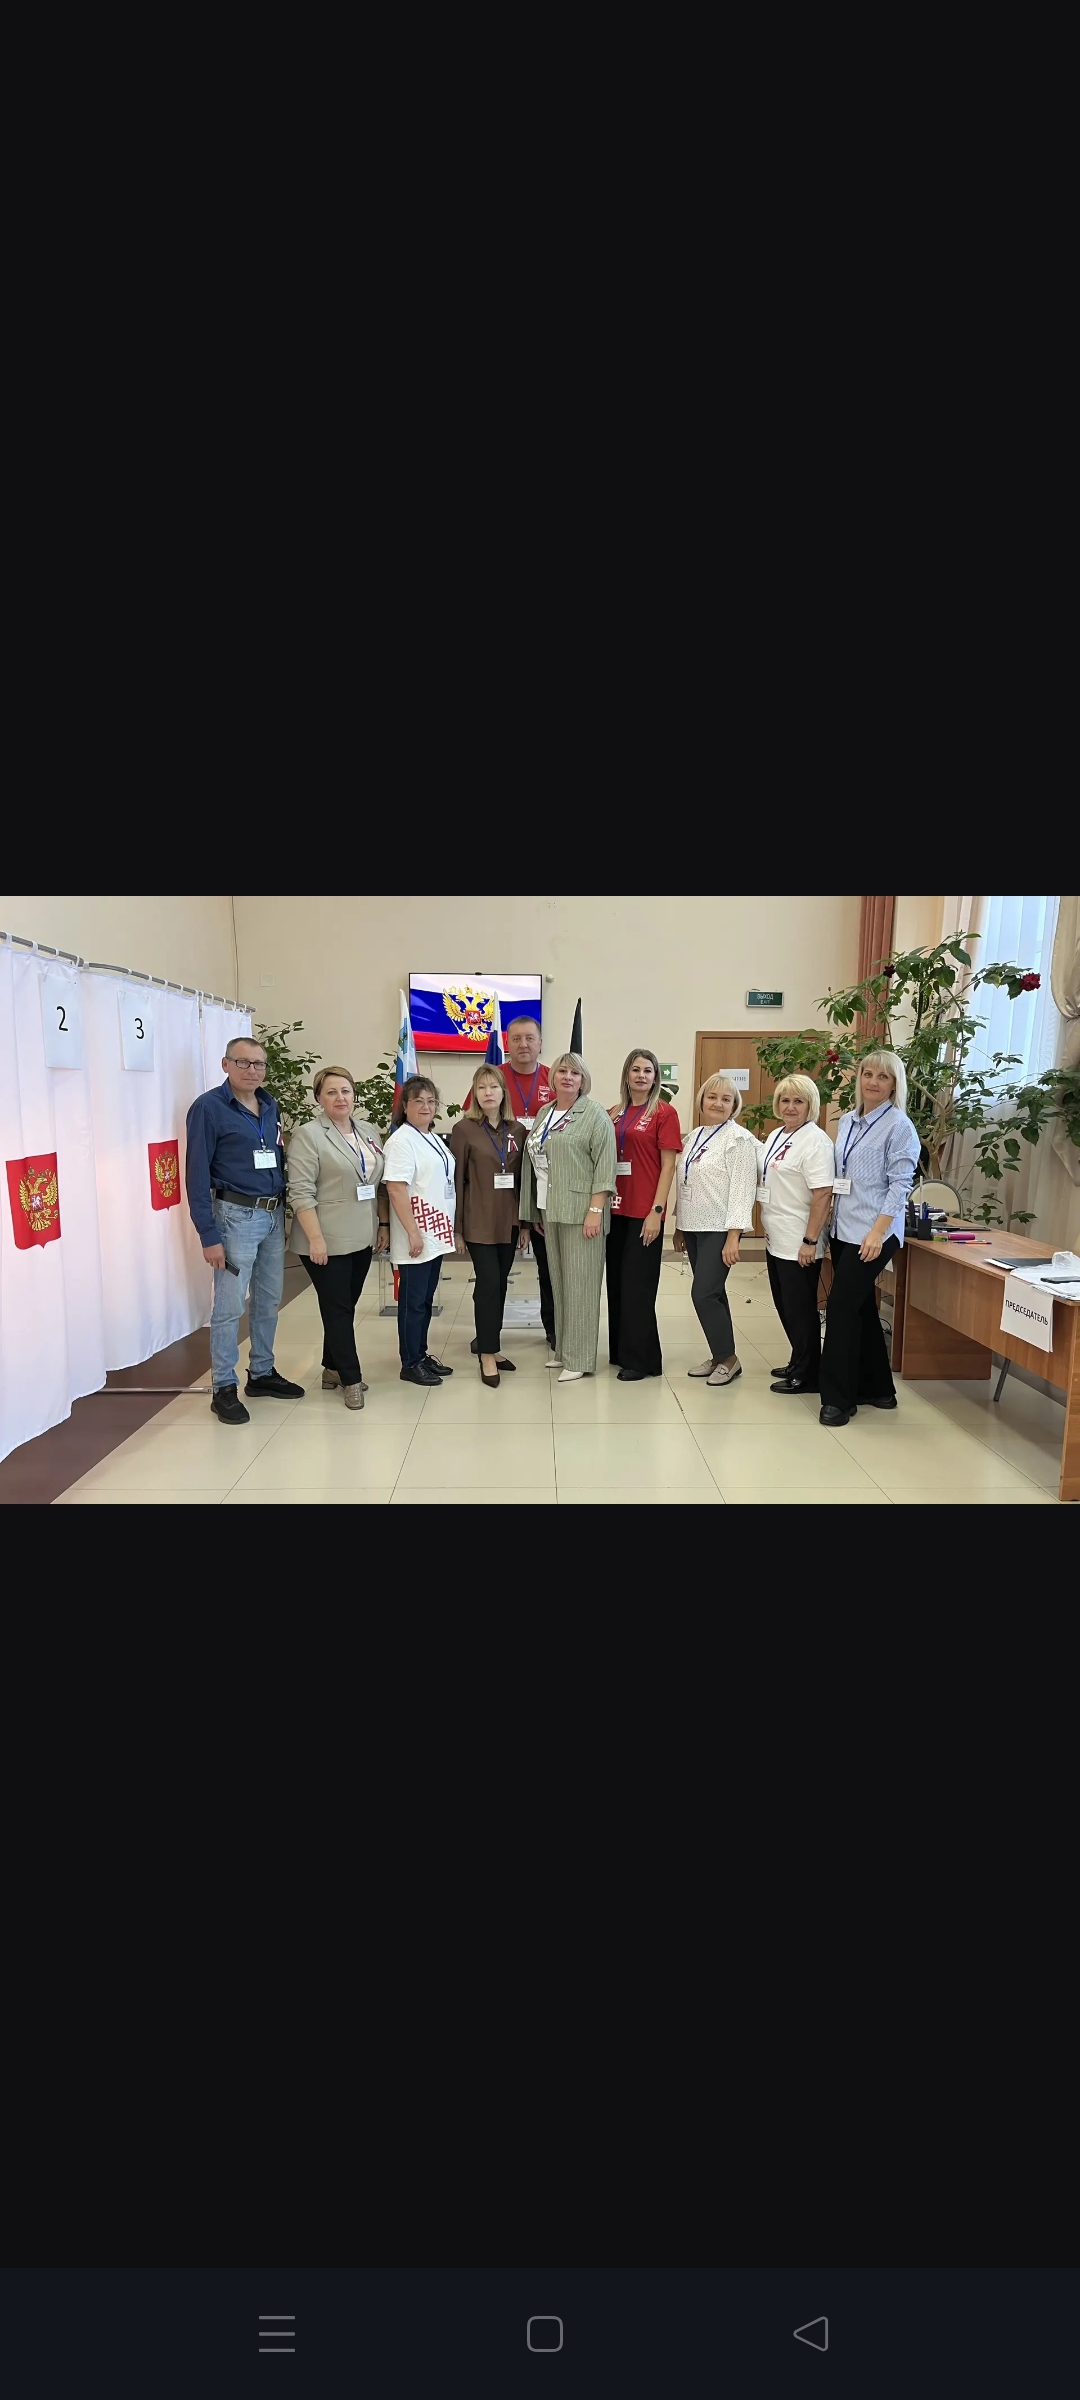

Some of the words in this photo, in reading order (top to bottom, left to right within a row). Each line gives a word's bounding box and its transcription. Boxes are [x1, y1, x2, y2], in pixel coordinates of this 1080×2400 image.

[56, 1006, 68, 1031] 2
[134, 1018, 144, 1039] 3
[1005, 1300, 1048, 1325] ПРЕДСЕДАТЕЛЬ
